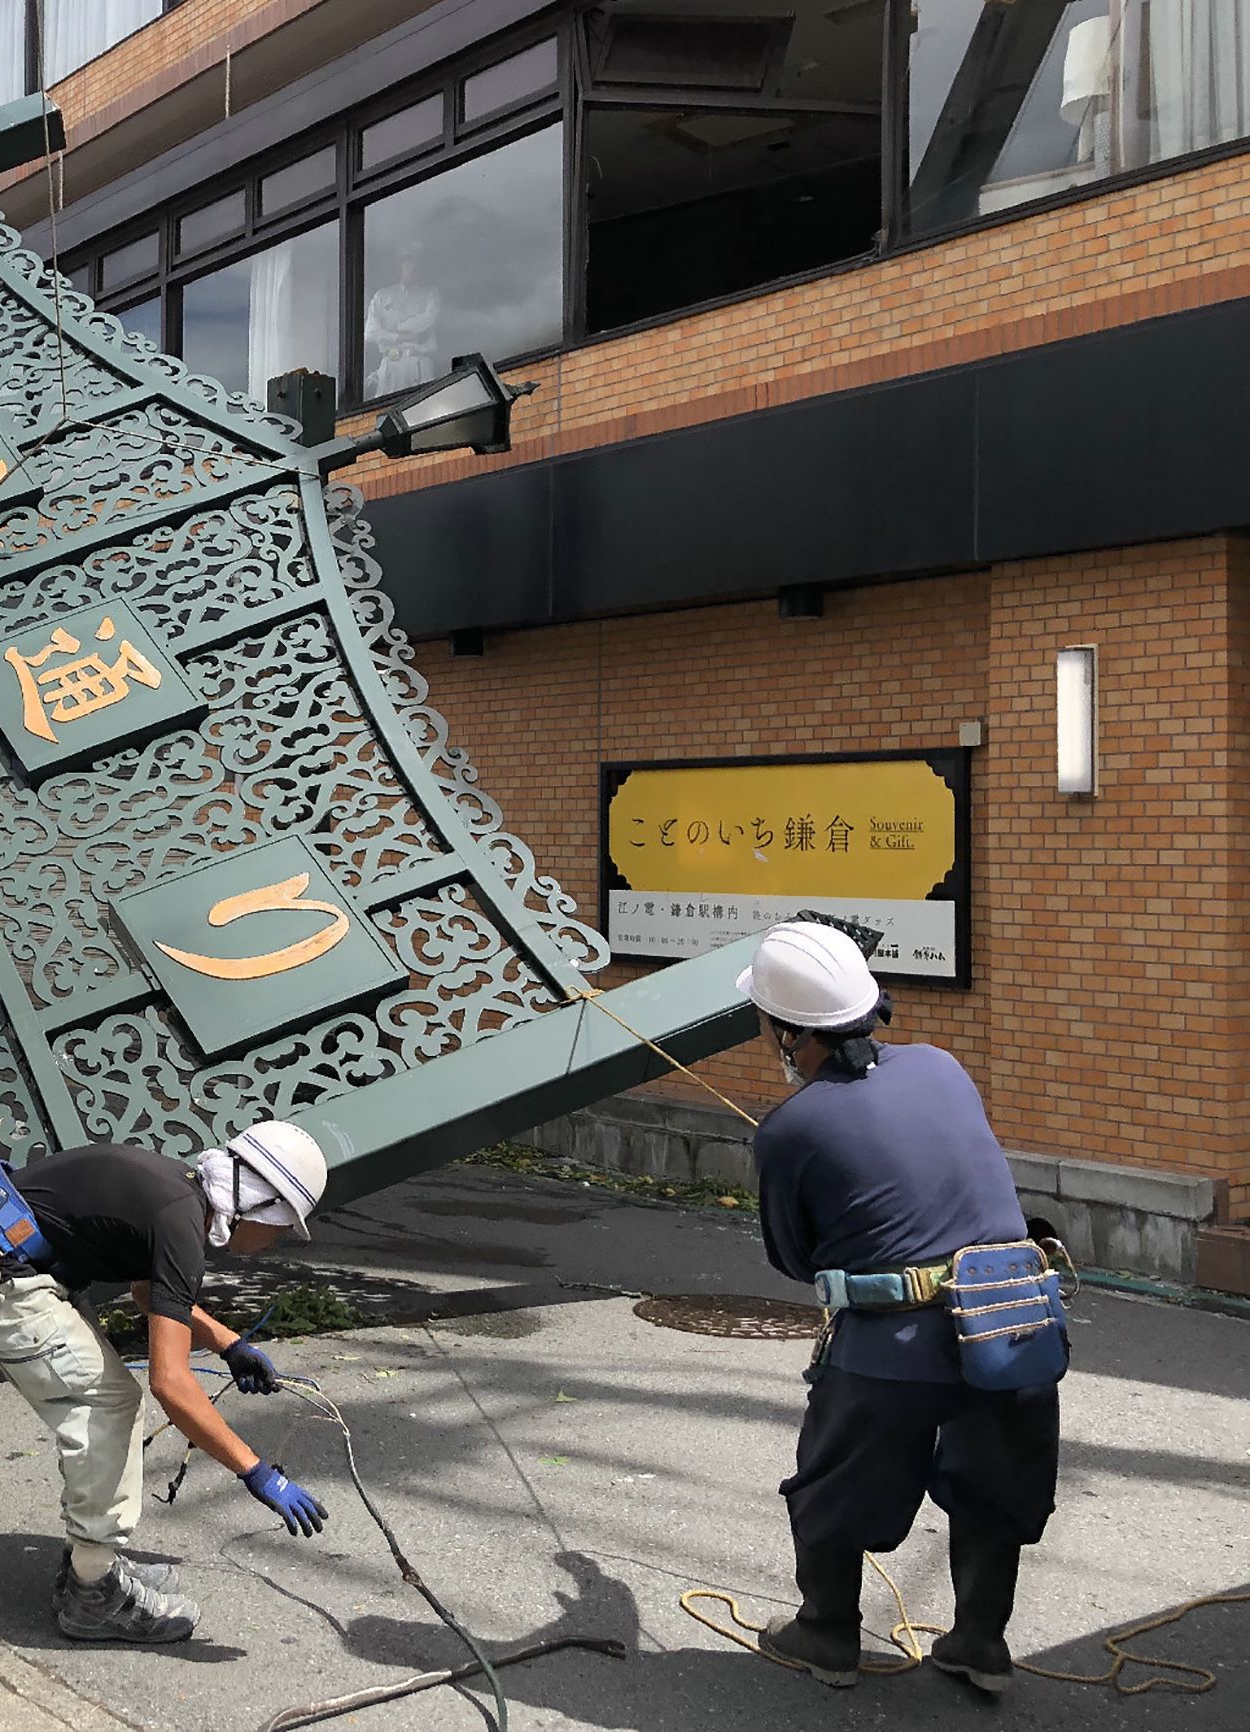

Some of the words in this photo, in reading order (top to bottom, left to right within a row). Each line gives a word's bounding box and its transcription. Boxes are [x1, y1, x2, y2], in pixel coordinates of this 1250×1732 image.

[870, 815, 924, 831] Souvenir
[629, 814, 855, 854] ことのいち鎌倉
[870, 835, 881, 848] &
